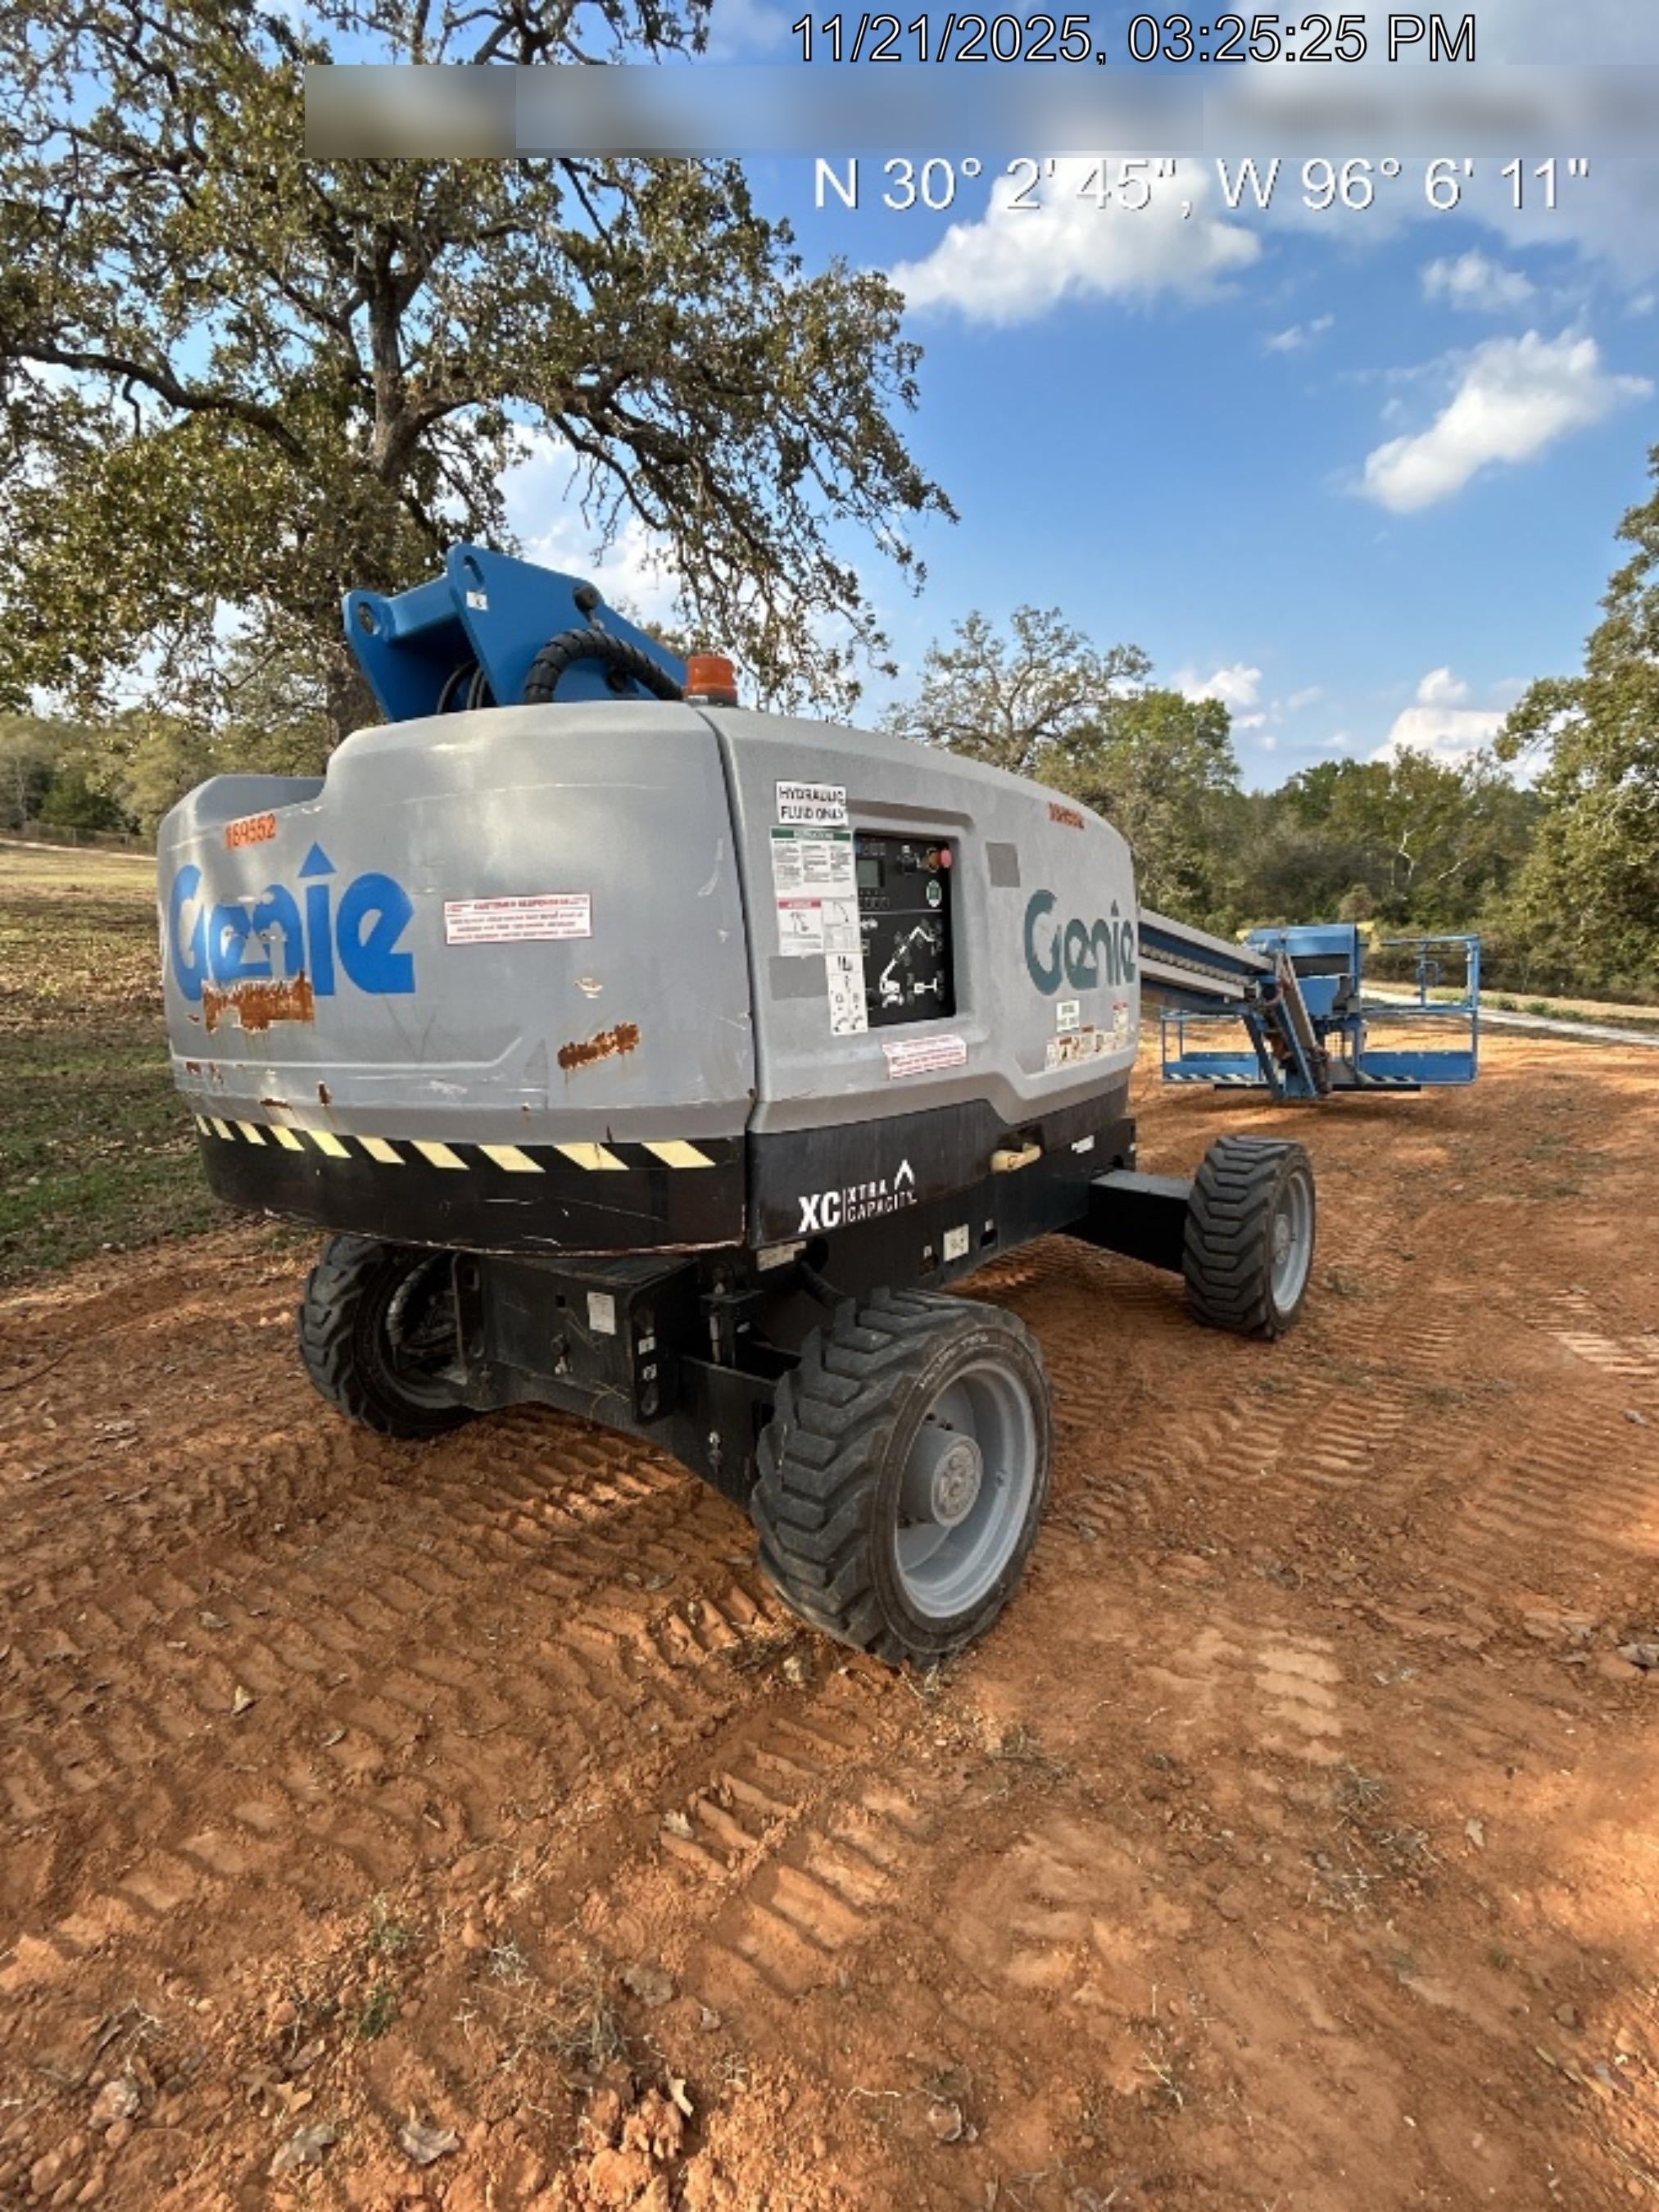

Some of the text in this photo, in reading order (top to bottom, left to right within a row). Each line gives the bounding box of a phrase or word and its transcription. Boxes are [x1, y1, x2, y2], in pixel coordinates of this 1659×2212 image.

[781, 805, 814, 820] FLUID
[169, 841, 416, 1001] Genie
[1024, 889, 1136, 997] Genie
[846, 1178, 888, 1205] XTRA
[846, 1189, 918, 1223] CAPACITY
[797, 1190, 841, 1234] XC
